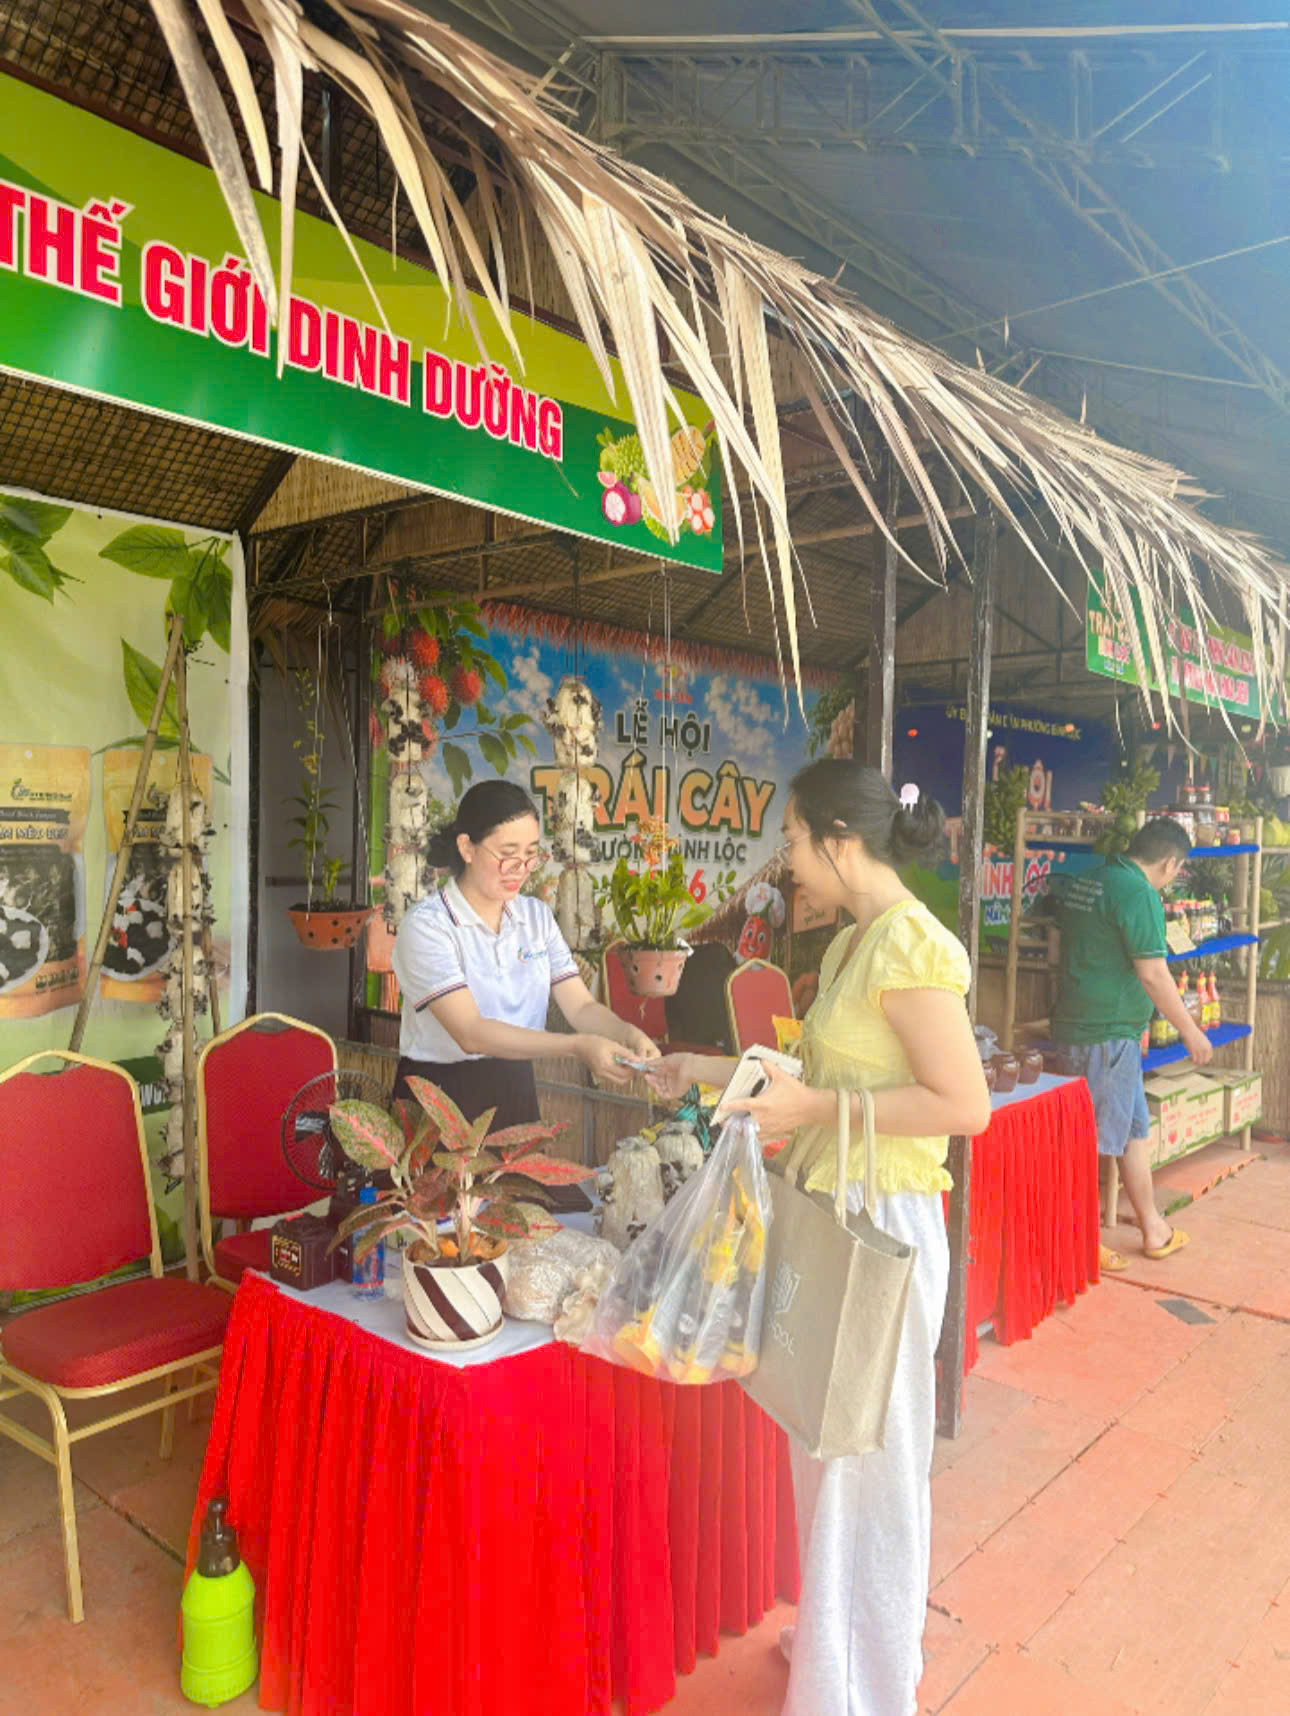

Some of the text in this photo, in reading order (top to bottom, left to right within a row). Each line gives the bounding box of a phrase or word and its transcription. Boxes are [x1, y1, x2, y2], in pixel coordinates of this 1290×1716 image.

[0, 180, 563, 463] THẾ GIỚI DINH DƯỠNG
[614, 700, 713, 758] LỄ HỘI
[678, 760, 776, 838] CÂY
[714, 837, 748, 867] LỘC
